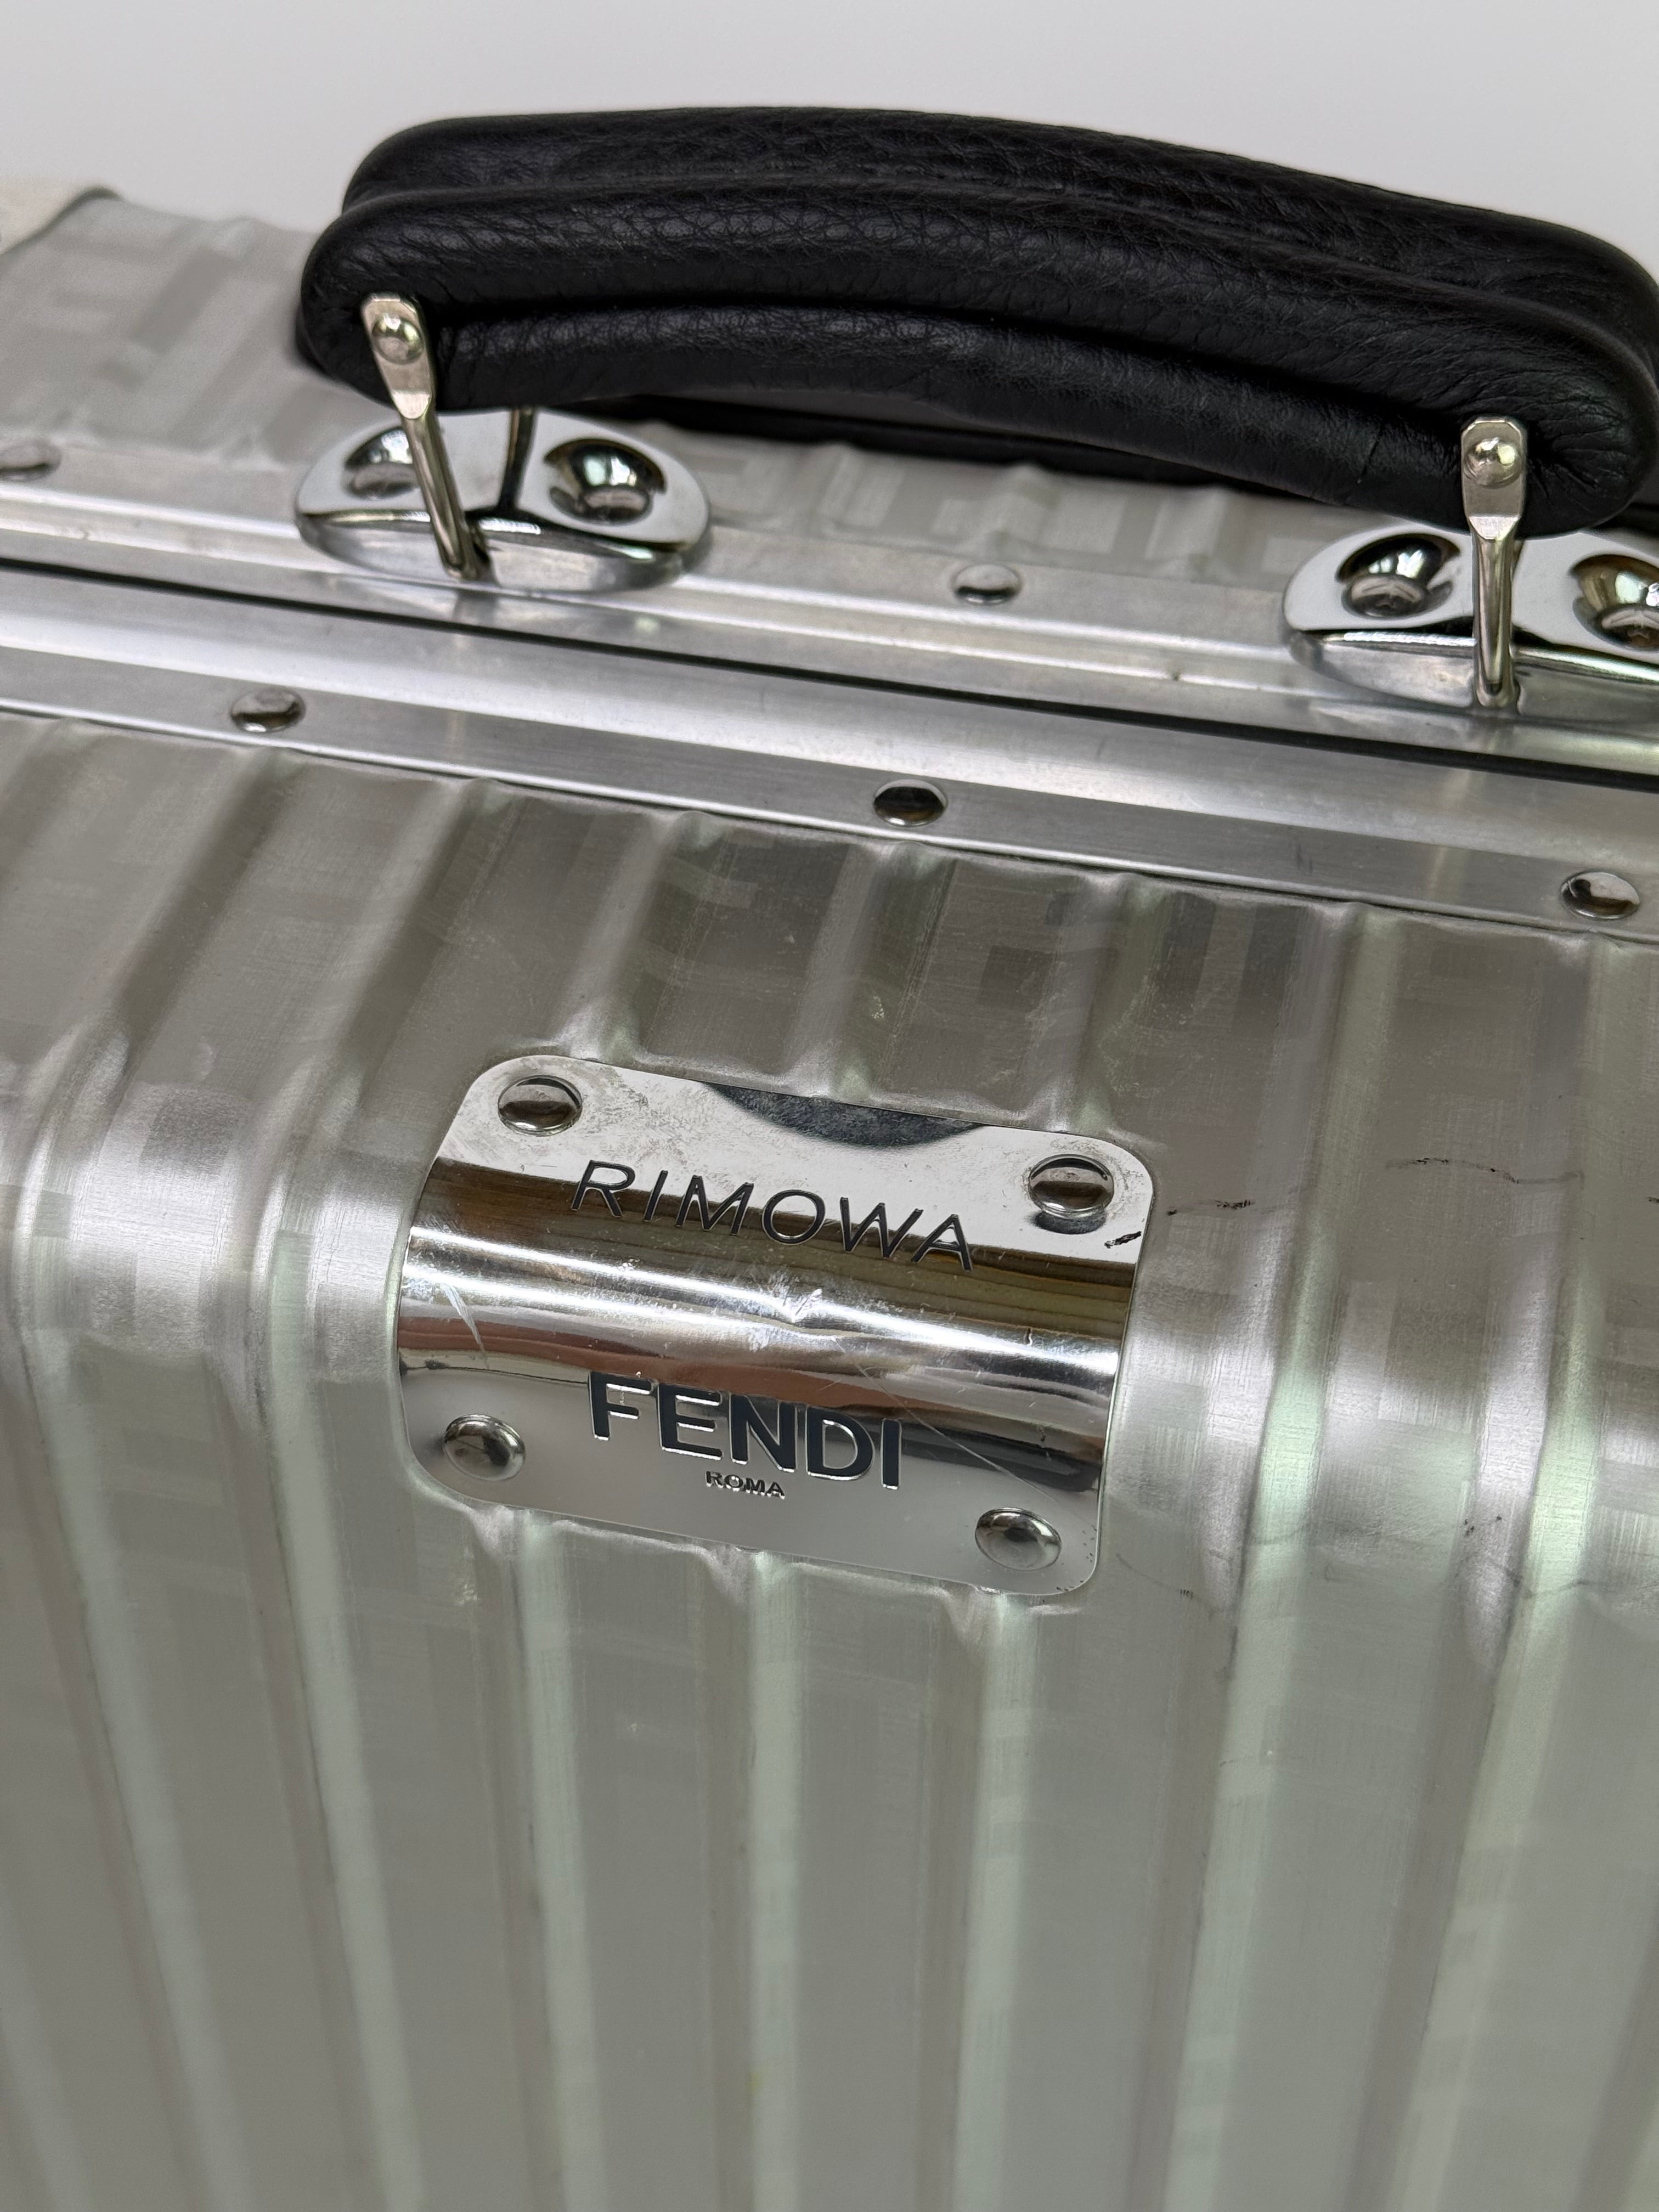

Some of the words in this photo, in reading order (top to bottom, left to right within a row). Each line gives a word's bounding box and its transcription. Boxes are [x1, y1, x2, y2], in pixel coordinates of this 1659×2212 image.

[571, 1160, 974, 1271] RIMOWA
[588, 1371, 902, 1490] FENDI
[705, 1470, 786, 1500] ROMA
